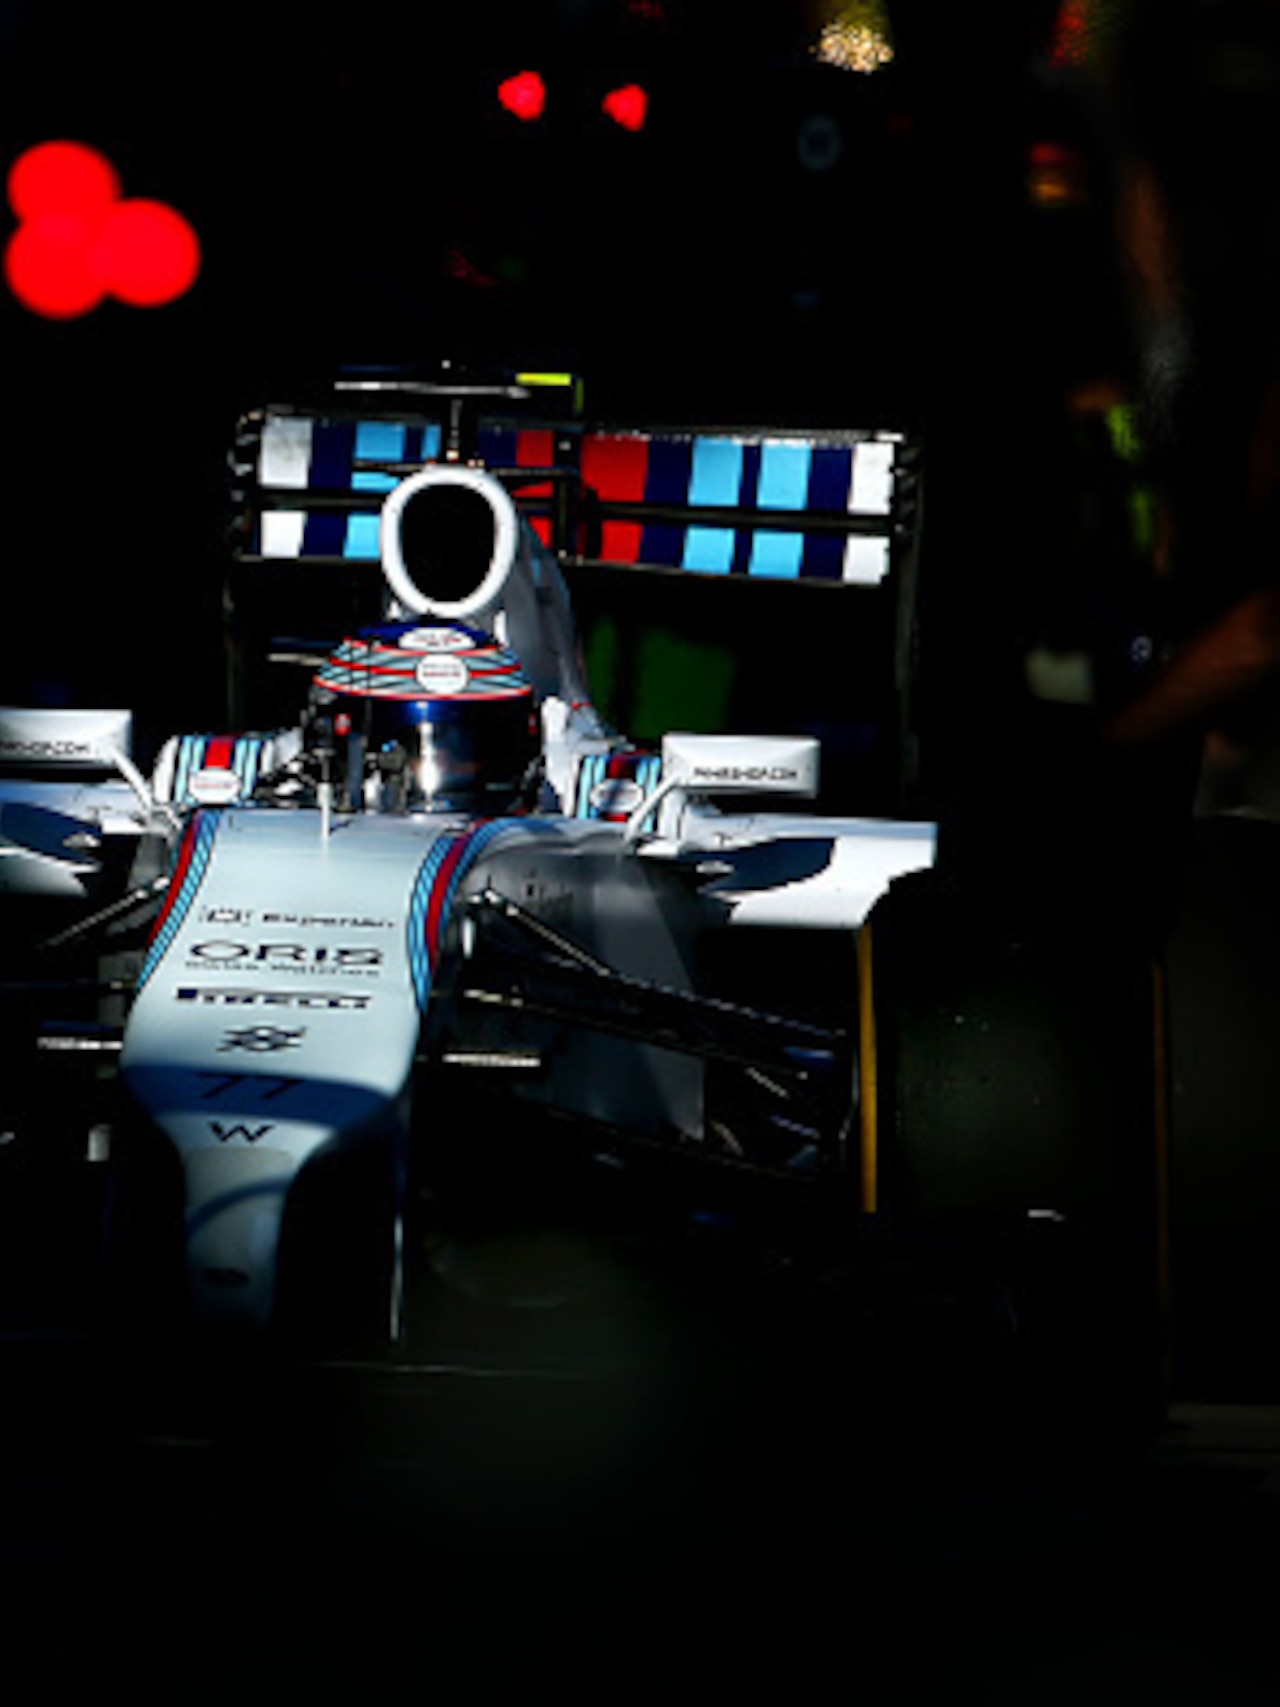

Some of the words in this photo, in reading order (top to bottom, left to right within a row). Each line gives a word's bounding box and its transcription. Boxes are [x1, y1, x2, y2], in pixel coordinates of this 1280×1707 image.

[190, 941, 384, 964] ORIS
[195, 1073, 307, 1099] 77
[207, 1120, 276, 1142] W
